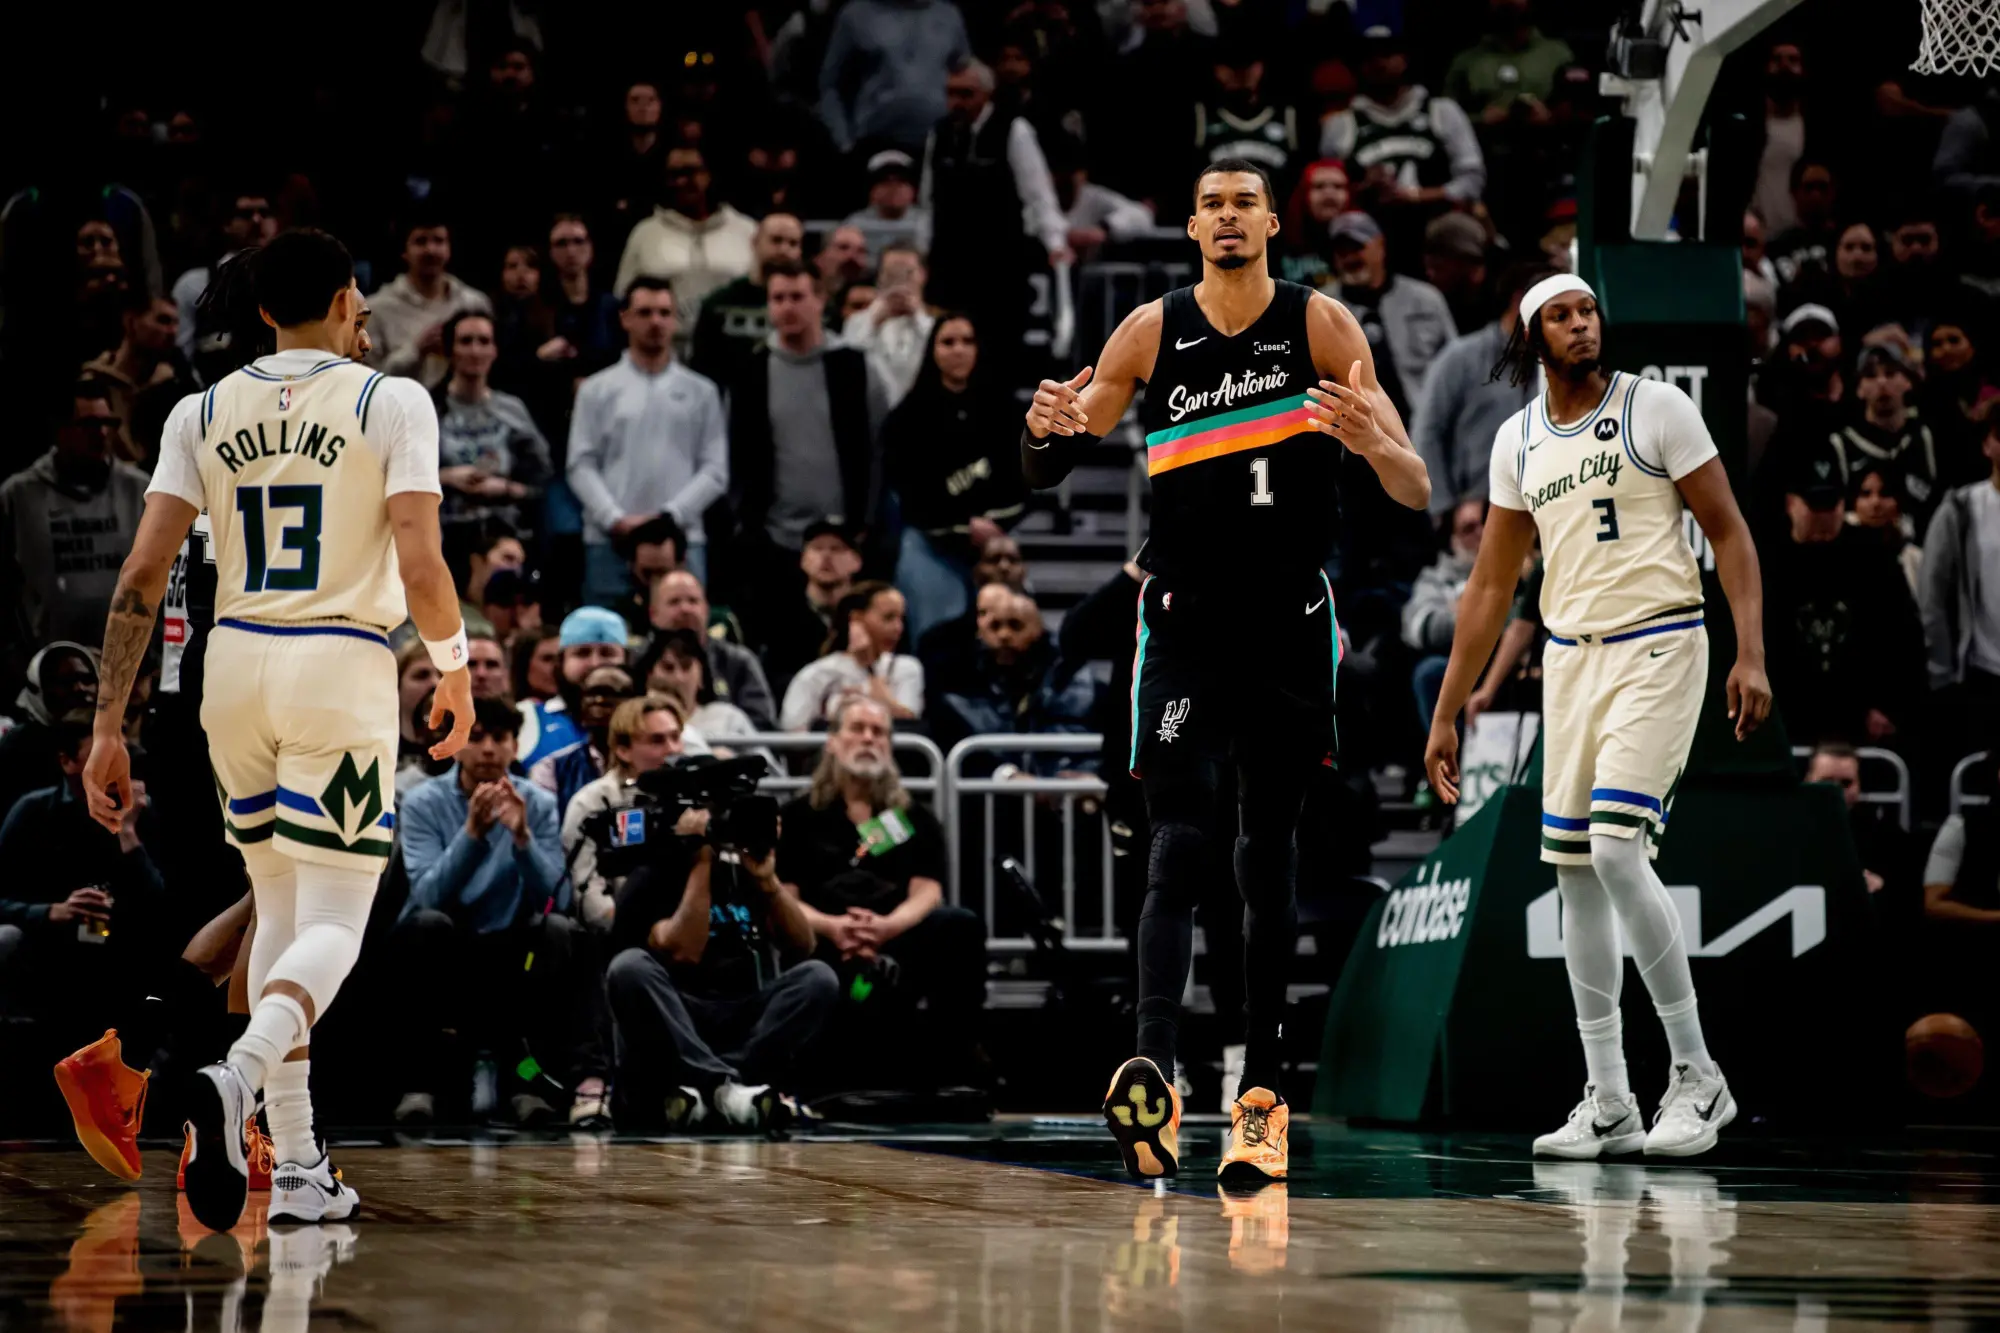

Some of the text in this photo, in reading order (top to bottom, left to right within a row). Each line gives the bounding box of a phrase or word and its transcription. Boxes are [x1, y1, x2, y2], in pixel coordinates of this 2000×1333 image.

[1167, 364, 1290, 422] San Antonio
[215, 420, 346, 474] ROLLINS
[1579, 450, 1624, 487] City
[1250, 457, 1274, 506] 1
[236, 484, 323, 592] 13
[1592, 498, 1619, 542] 3
[1376, 860, 1472, 949] coinbase
